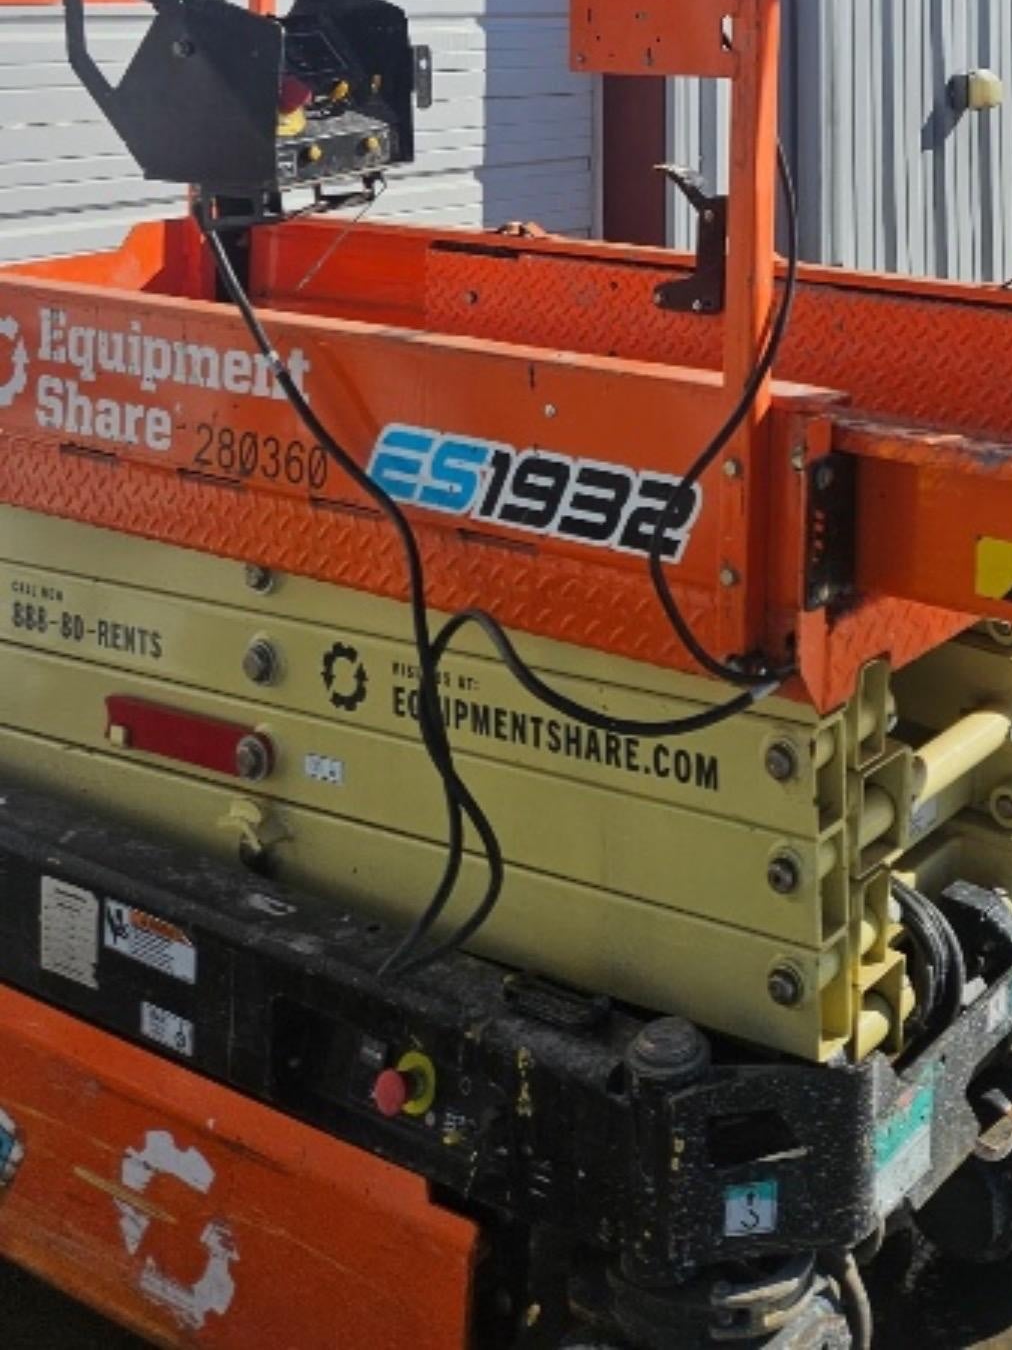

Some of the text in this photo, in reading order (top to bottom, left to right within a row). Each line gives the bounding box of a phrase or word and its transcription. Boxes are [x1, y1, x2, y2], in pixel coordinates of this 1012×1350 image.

[37, 307, 311, 404] Equipment
[36, 374, 172, 451] Share
[193, 423, 328, 489] 280360
[369, 427, 701, 561] ES1932
[393, 685, 719, 791] EQIPMENTSHARE.COM
